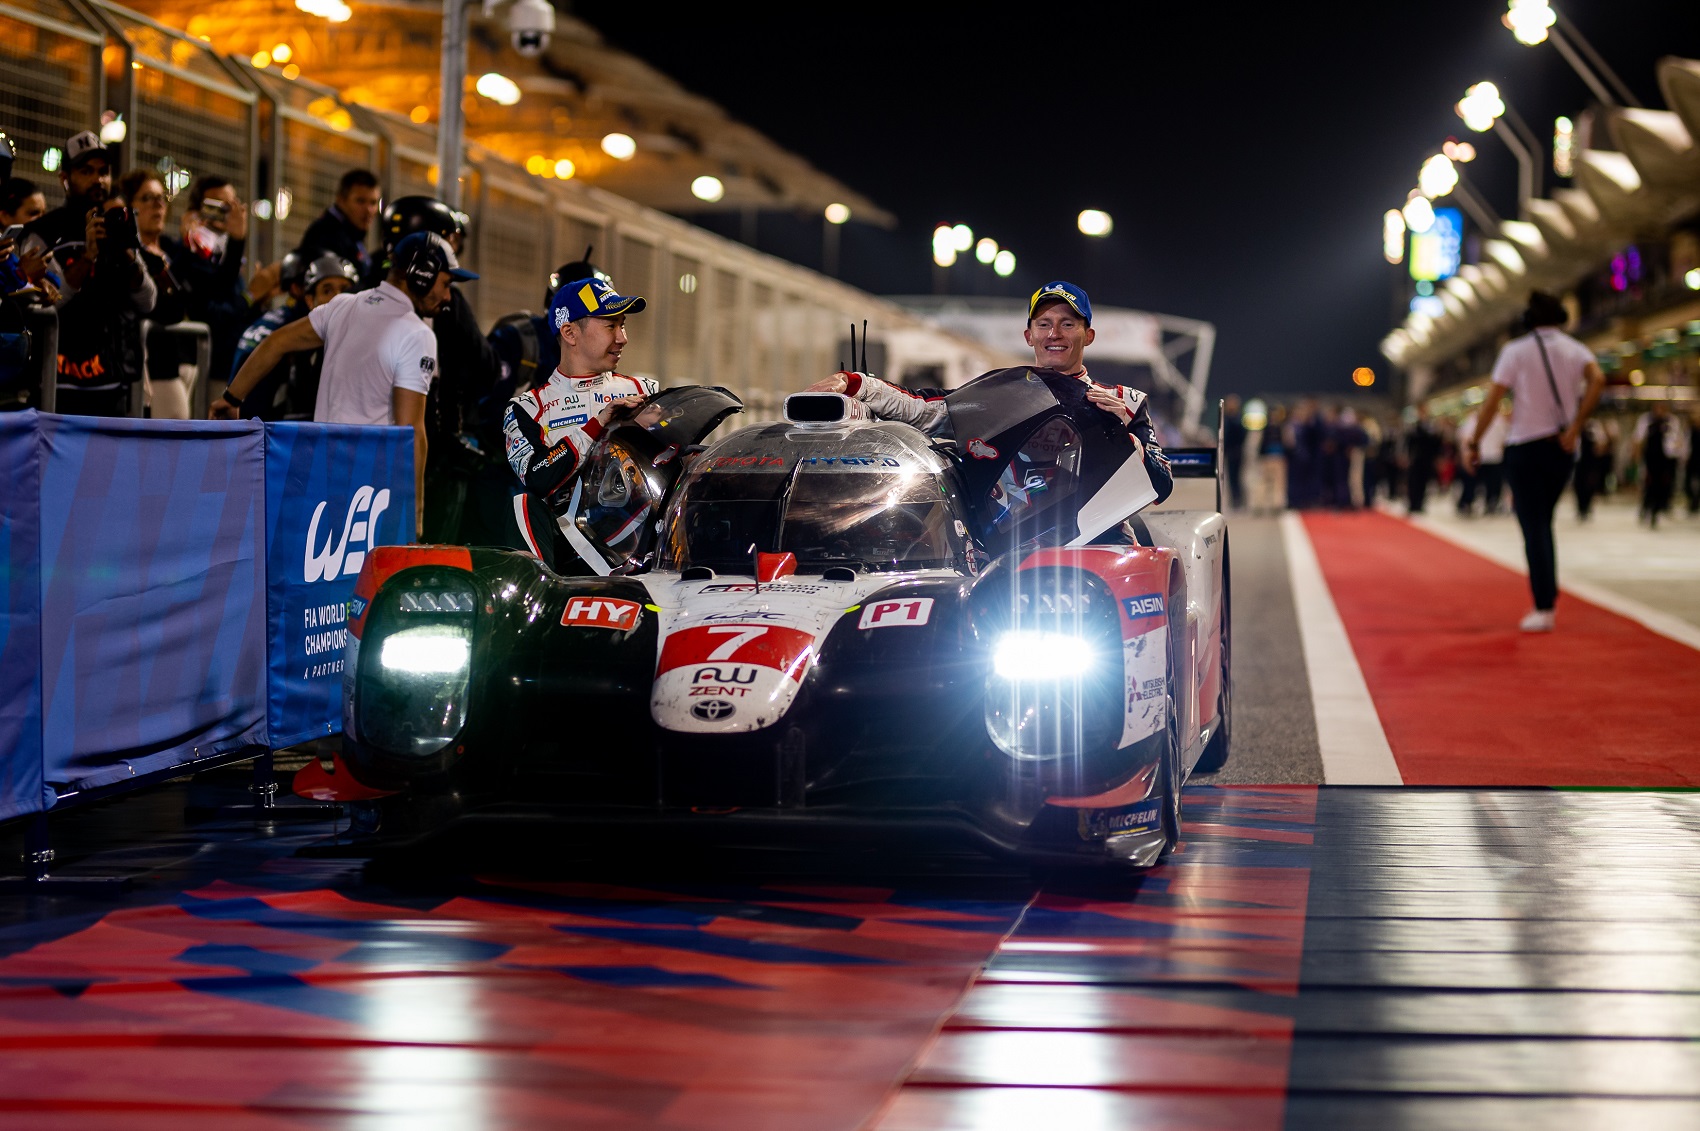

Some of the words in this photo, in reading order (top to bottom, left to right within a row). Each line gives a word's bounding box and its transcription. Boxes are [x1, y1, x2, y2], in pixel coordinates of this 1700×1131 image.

[551, 416, 584, 428] MICHELIN
[715, 456, 785, 467] TOYOTA
[304, 606, 318, 629] FIA
[318, 602, 345, 626] WORLD
[567, 600, 635, 623] HY
[870, 601, 922, 623] P1
[1130, 597, 1164, 616] AISIN
[304, 628, 348, 656] CHAMPIONS
[706, 626, 770, 661] 7
[303, 667, 309, 680] A
[312, 659, 345, 678] PARTNER
[688, 686, 752, 697] ZENT
[1142, 686, 1164, 700] ELECTRIC
[1109, 808, 1159, 829] MICHELIN
